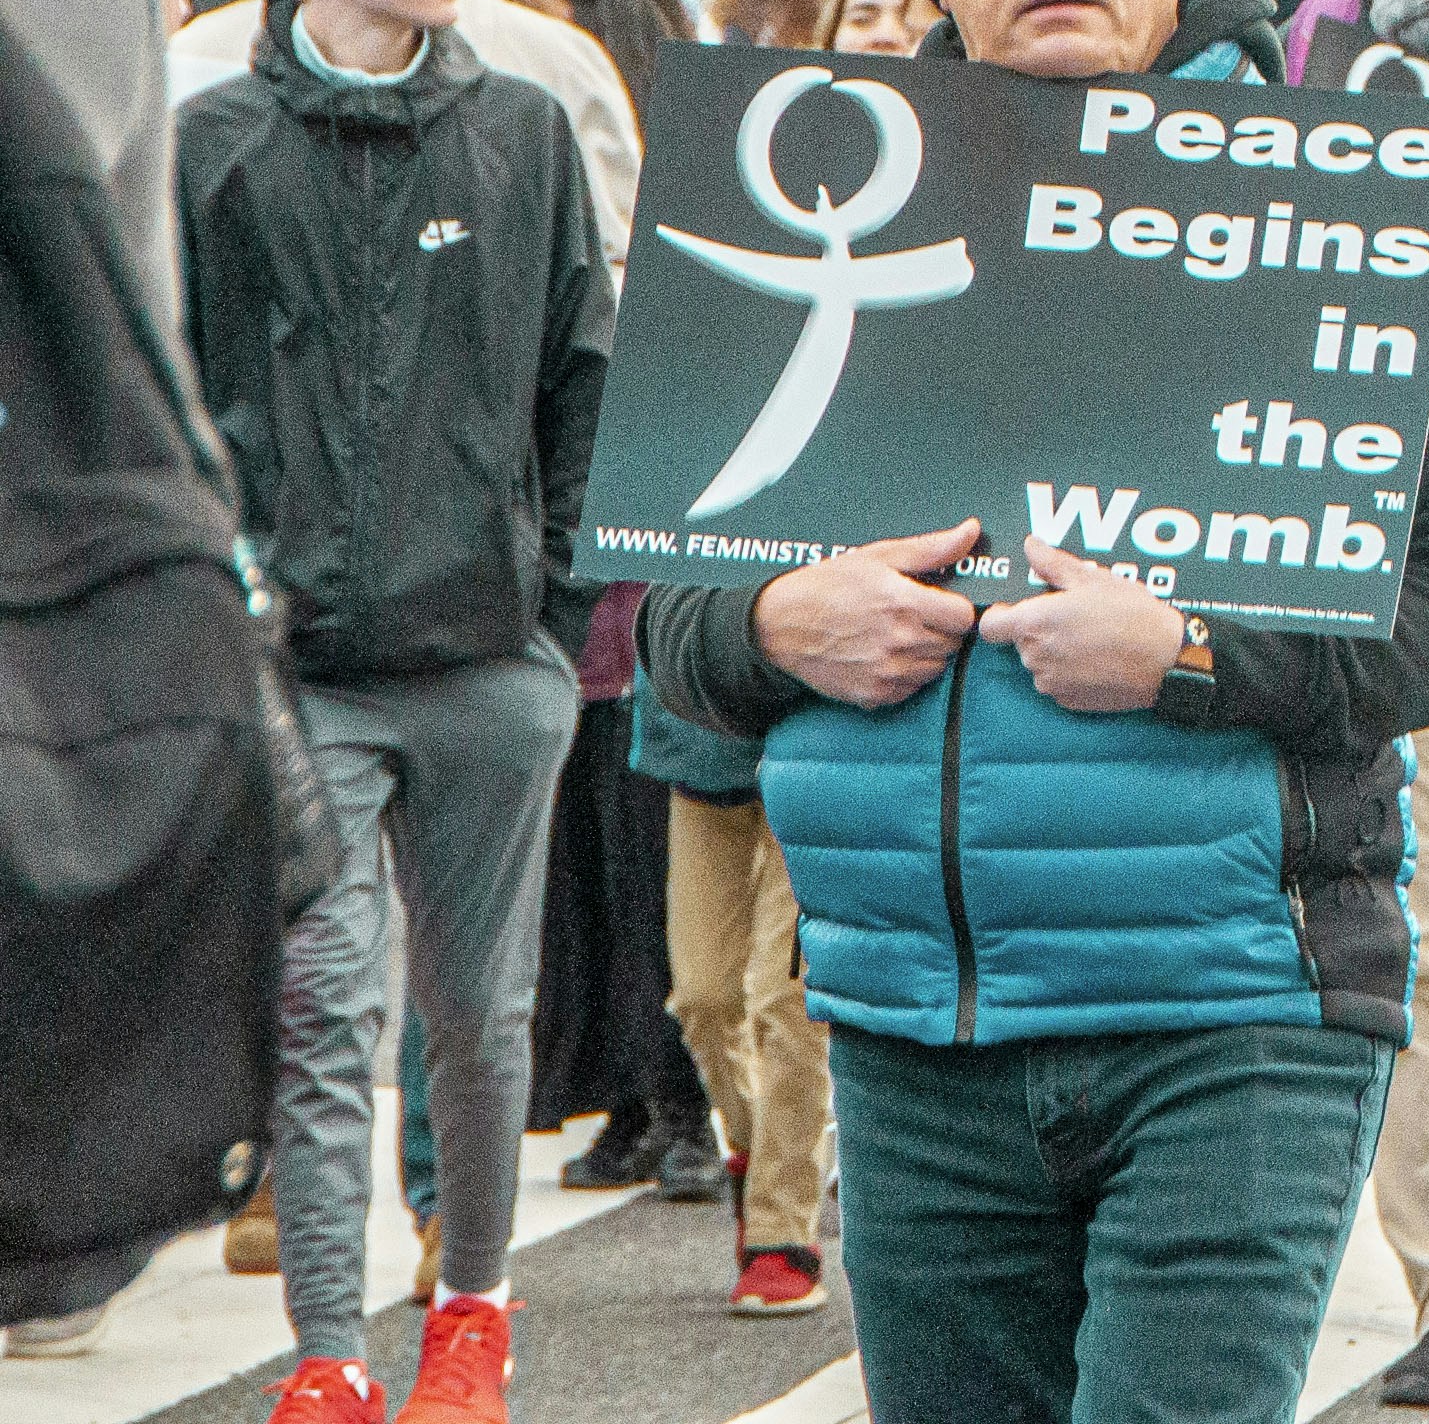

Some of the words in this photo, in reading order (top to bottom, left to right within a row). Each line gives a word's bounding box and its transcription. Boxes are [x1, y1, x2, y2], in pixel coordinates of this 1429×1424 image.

[1313, 305, 1417, 377] in
[1211, 399, 1404, 474] the
[685, 532, 823, 566] FEMINISTS
